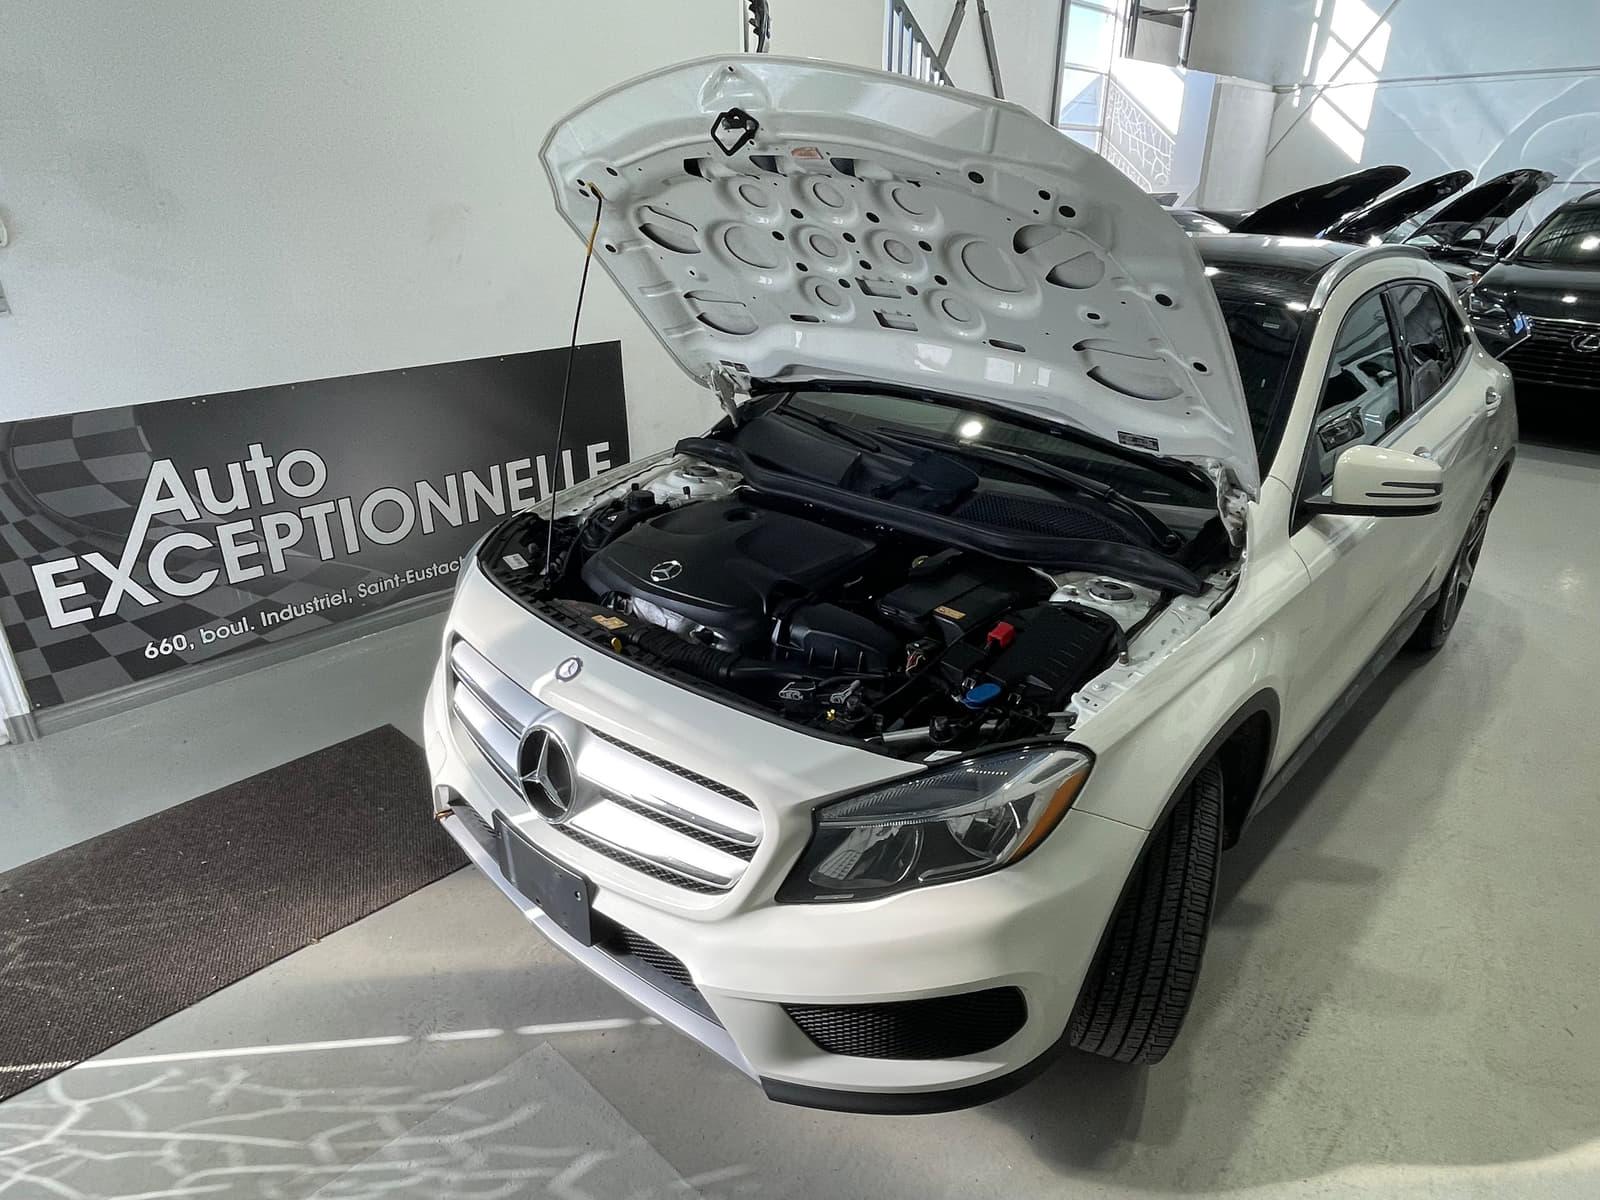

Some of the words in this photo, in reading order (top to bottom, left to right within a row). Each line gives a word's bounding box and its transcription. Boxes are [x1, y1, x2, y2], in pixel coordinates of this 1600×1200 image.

[131, 442, 328, 521] Auto
[31, 441, 611, 629] EXCEPTIONNELLE
[144, 634, 195, 660] 660,
[200, 617, 255, 644] boul.
[260, 588, 353, 627] Industriel,
